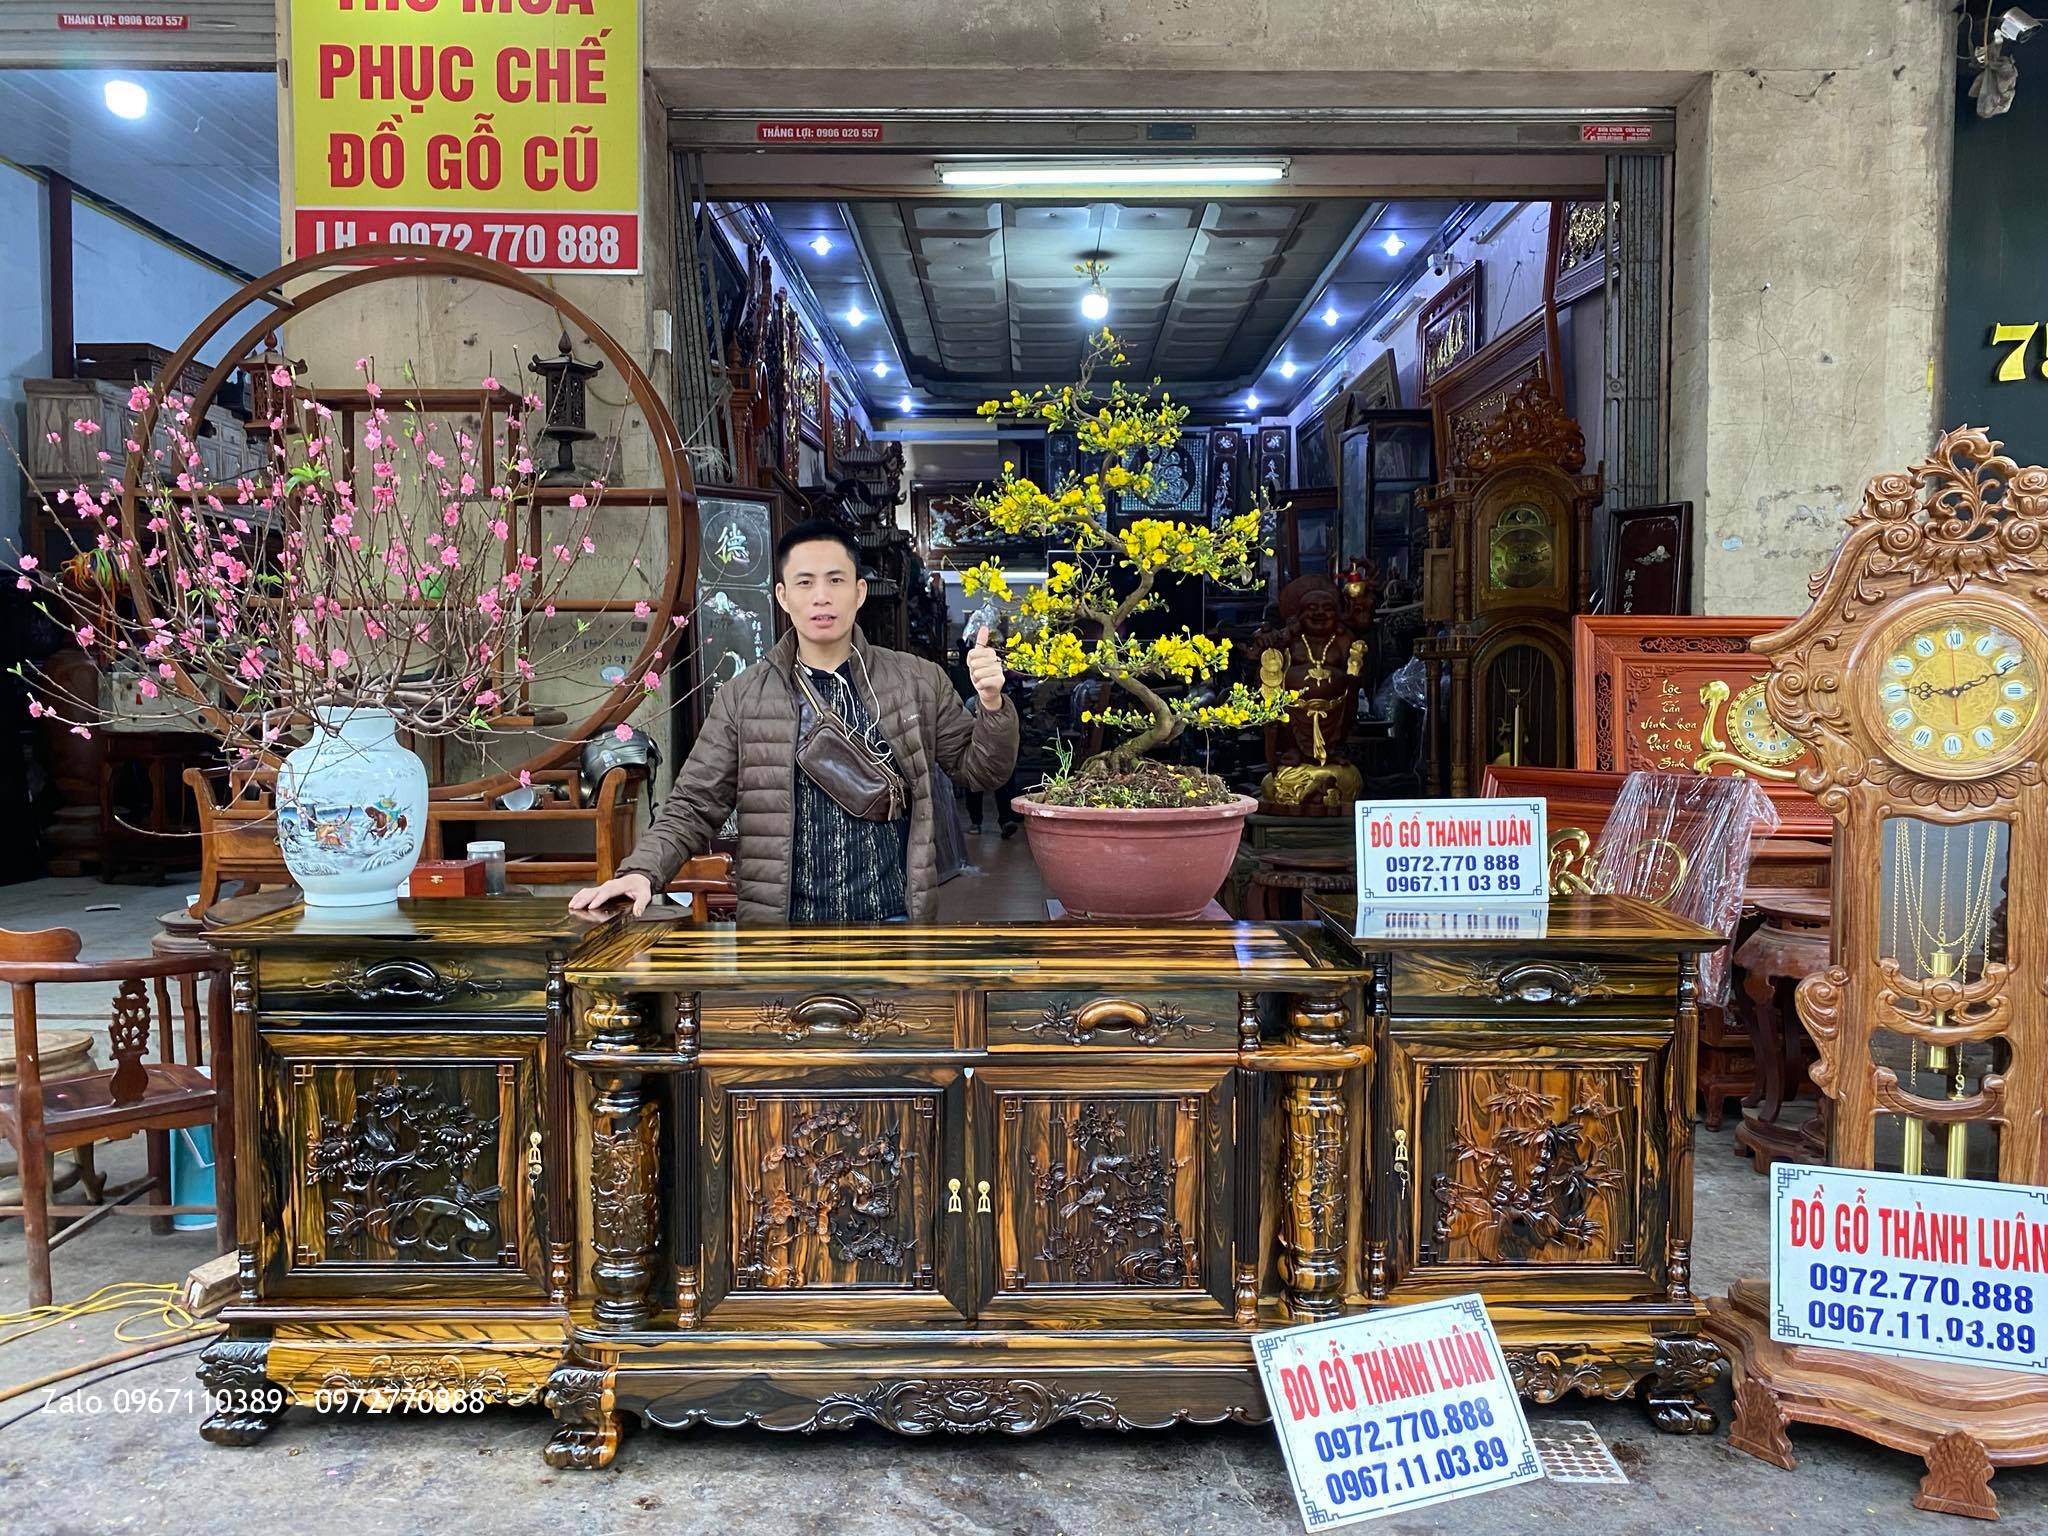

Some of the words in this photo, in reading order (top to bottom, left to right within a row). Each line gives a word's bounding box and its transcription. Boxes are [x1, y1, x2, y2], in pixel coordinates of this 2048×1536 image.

[118, 15, 142, 25] 0906
[145, 15, 162, 26] 020
[165, 16, 183, 26] 557
[319, 44, 475, 114] PHỤC
[496, 29, 613, 104] CHẾ
[328, 113, 405, 189] ĐỒ
[427, 113, 502, 191] GỖ
[523, 125, 599, 192] CŨ
[816, 128, 840, 138] 0906
[842, 128, 859, 138] 020
[861, 128, 879, 138] 557
[557, 224, 620, 264] 888
[1992, 322, 2048, 381] 7
[1370, 812, 1393, 848] ĐỒ
[1399, 811, 1421, 848] GỖ
[1426, 815, 1482, 848] THÀNH
[1487, 814, 1532, 847] LUÂN
[1386, 855, 1477, 873] 0972.770
[1483, 854, 1520, 871] 888
[1386, 875, 1460, 893] 0967.11
[1468, 875, 1491, 891] 03
[1497, 874, 1521, 890] 89
[1790, 1183, 1825, 1250] ĐỒ
[1835, 1186, 1869, 1255] GỖ
[1878, 1201, 1968, 1265] THÀNH
[1977, 1211, 2048, 1274] LUÂN
[1809, 1262, 2034, 1314] 0972.770.888
[1808, 1300, 2036, 1354] 0967.11.03.89
[1318, 1339, 1357, 1414] GỖ
[1352, 1340, 1435, 1406] THÀNH
[1427, 1324, 1496, 1390] LUÂN
[1314, 1396, 1495, 1463] 0972.770.888
[1325, 1436, 1509, 1505] 0967.11.03.89
